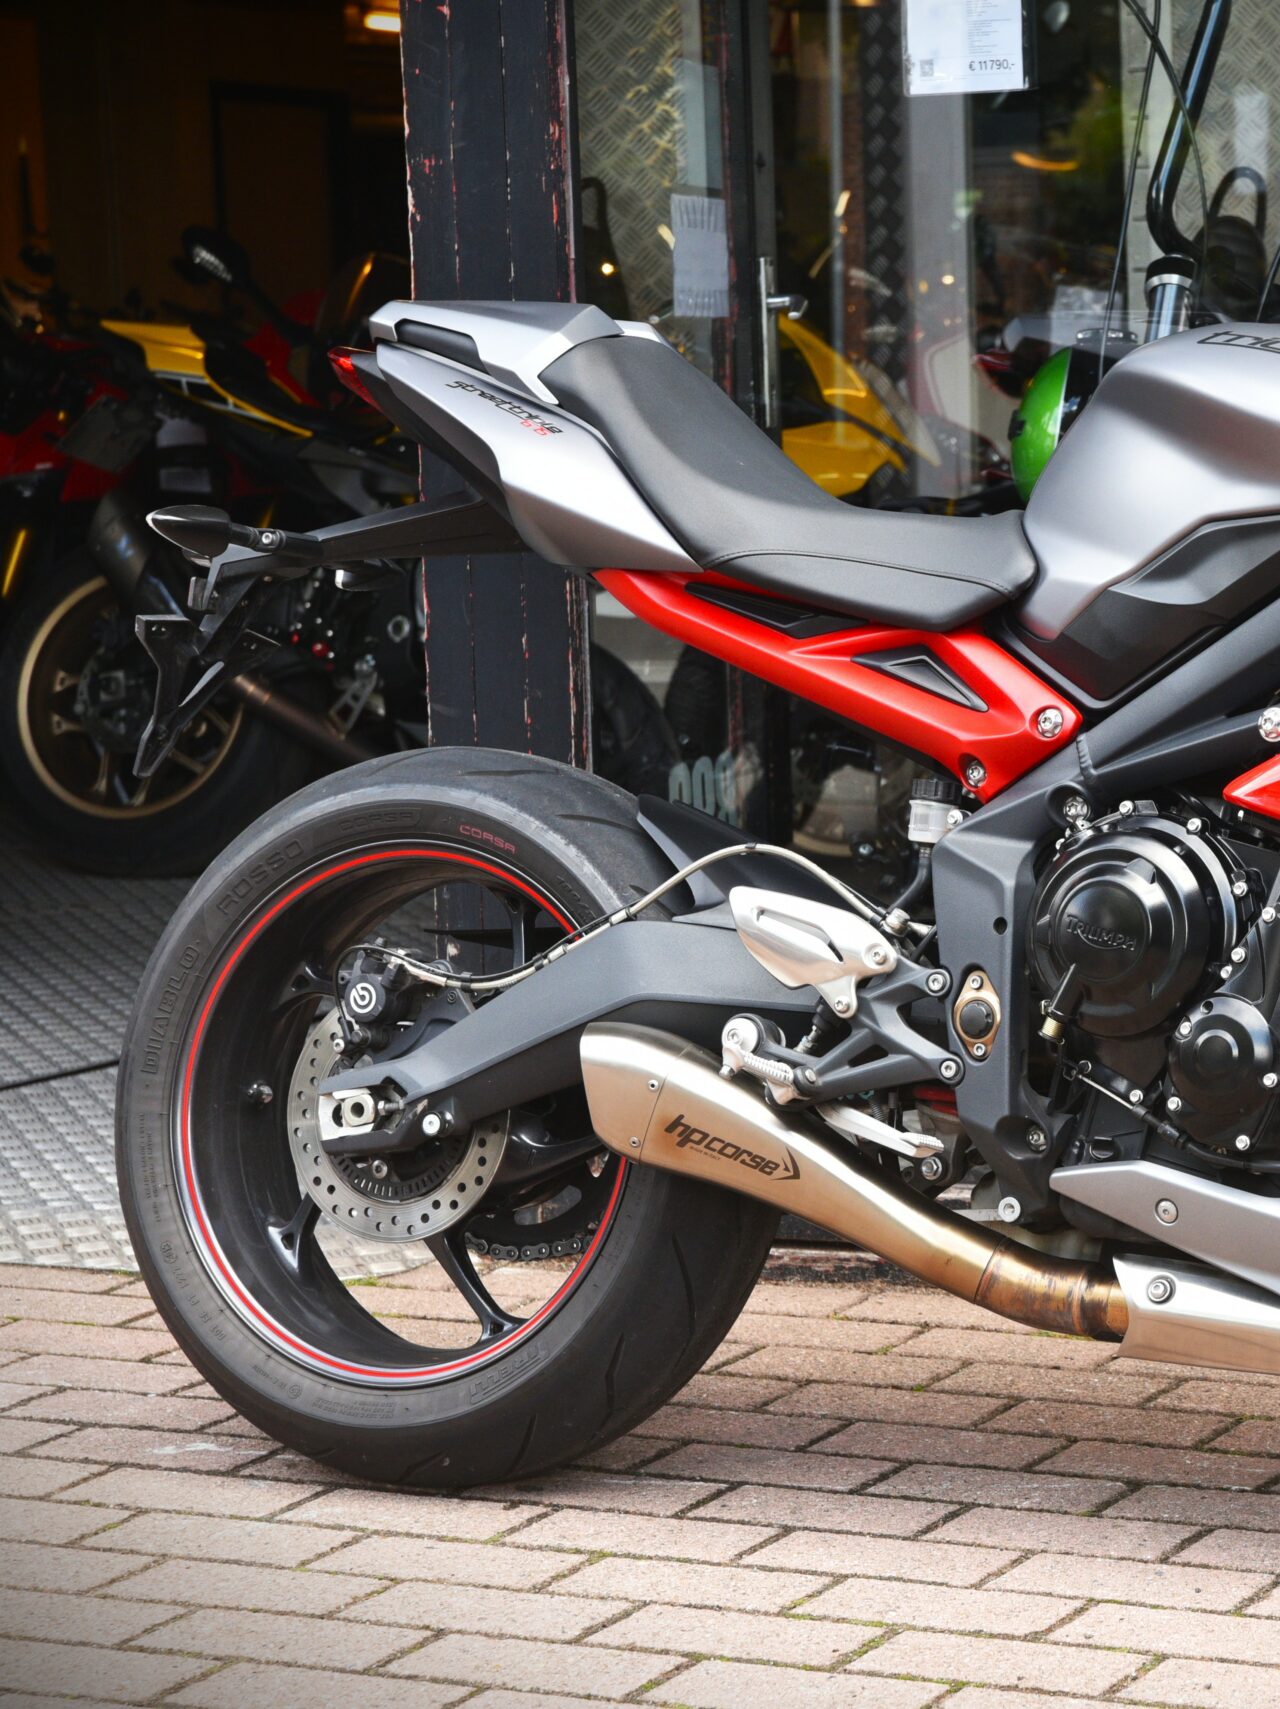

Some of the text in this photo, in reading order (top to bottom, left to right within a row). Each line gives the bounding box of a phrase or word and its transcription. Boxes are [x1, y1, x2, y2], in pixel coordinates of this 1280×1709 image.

[968, 60, 976, 71] €
[458, 823, 519, 856] CORSA
[215, 838, 304, 923] ROSSO
[1066, 914, 1138, 951] TRIUMPH
[140, 942, 201, 1075] DIABLO
